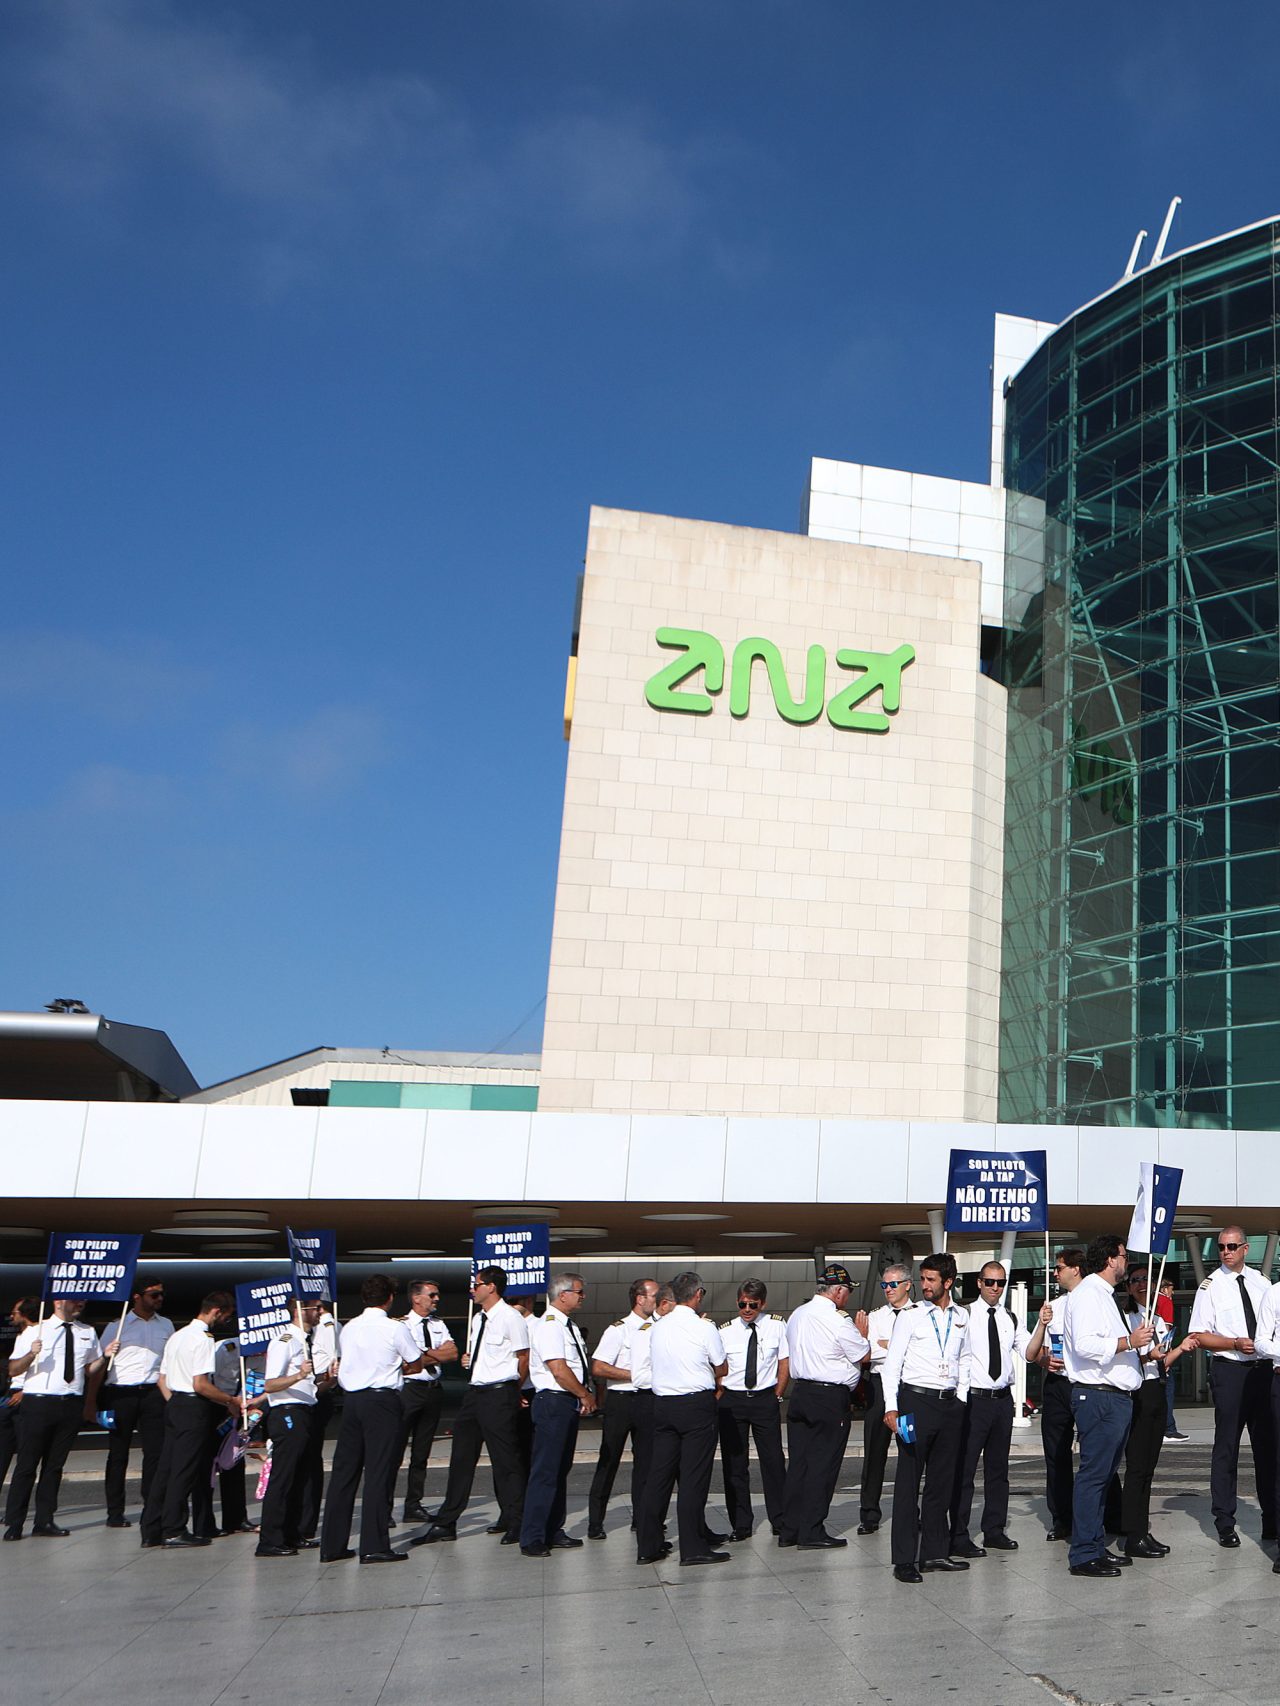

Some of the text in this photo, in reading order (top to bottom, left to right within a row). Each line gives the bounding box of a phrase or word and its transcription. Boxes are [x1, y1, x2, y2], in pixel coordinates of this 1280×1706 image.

[968, 1159, 1025, 1170] SOU PILOTO
[980, 1171, 1015, 1182] DA TAP
[956, 1185, 1037, 1204] NÃO TENHO
[961, 1206, 1031, 1222] DIREITOS
[485, 1231, 532, 1244] SOU PILOTO
[65, 1240, 120, 1250] SOU PILOTO
[495, 1243, 523, 1254] DA TAP
[73, 1250, 107, 1260] DA TAP
[526, 1255, 545, 1270] SOU
[49, 1262, 126, 1278] NÃO TENHO
[51, 1280, 116, 1293] DIREITOS
[250, 1282, 293, 1299] SOU PILOTO
[261, 1295, 287, 1308] DA TAP
[238, 1308, 291, 1330] E TAMBÉM
